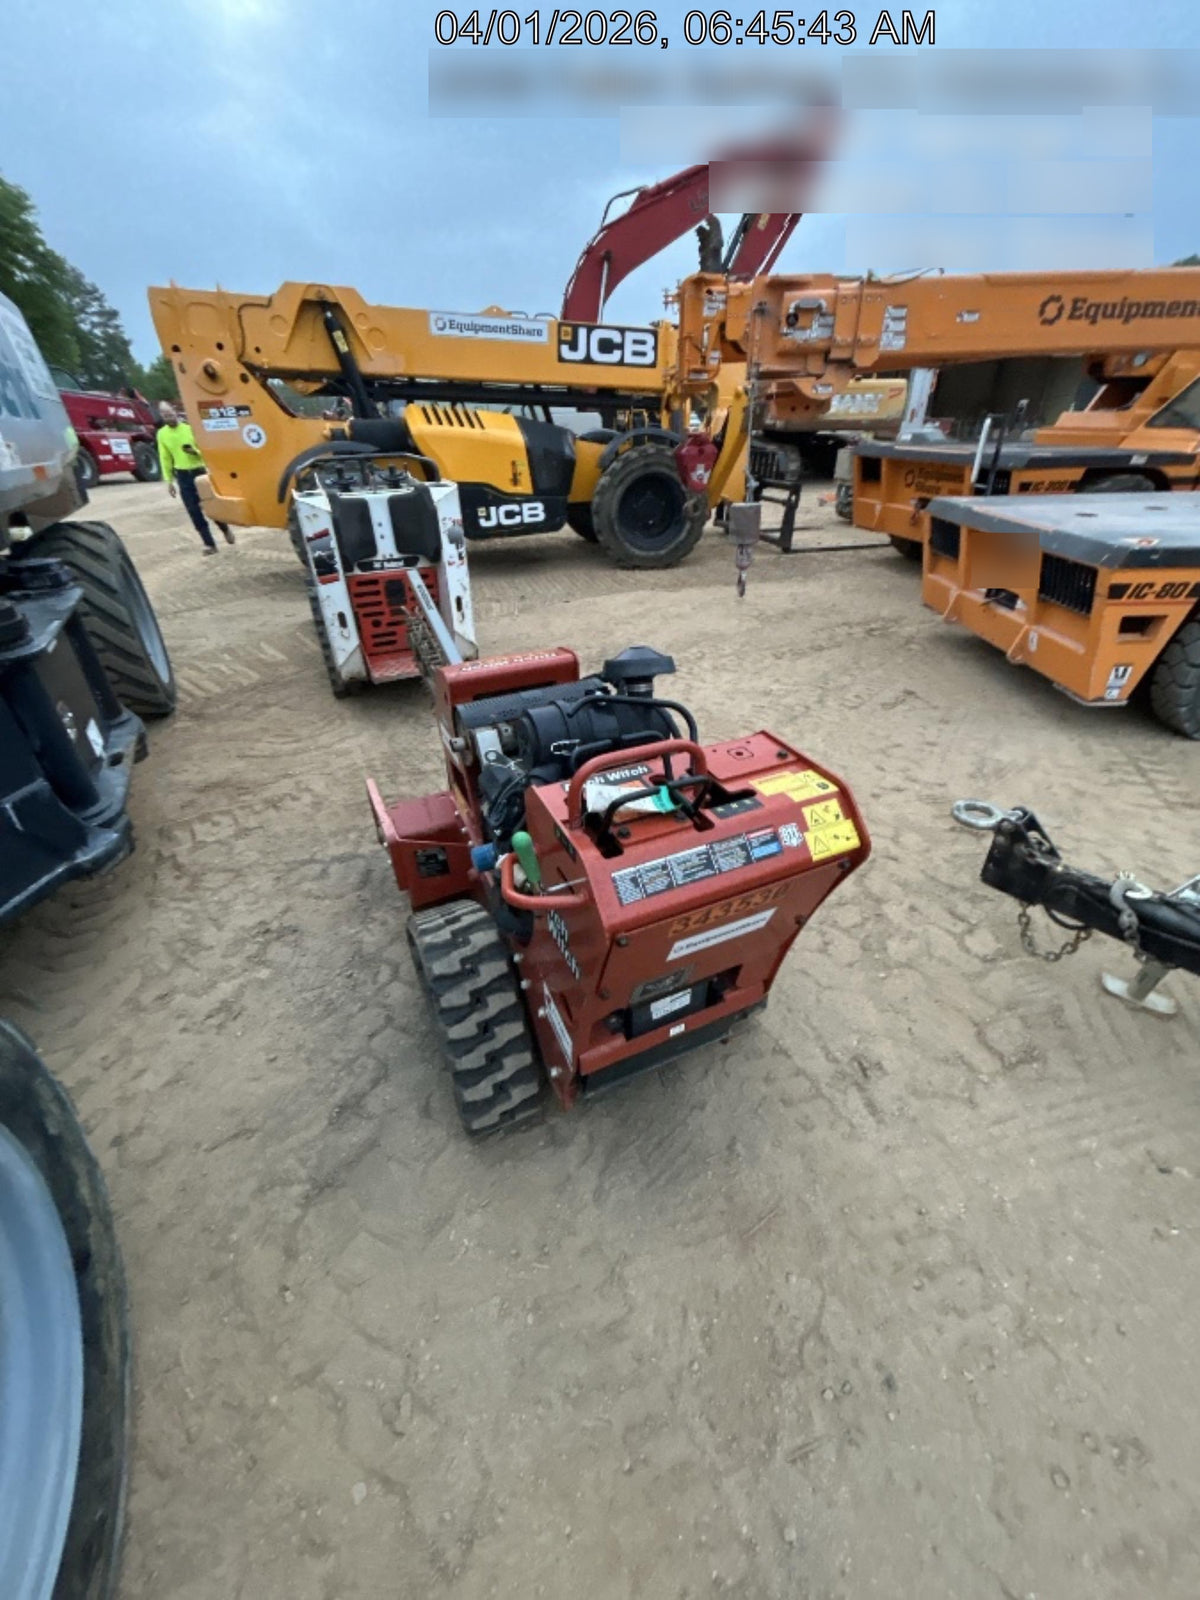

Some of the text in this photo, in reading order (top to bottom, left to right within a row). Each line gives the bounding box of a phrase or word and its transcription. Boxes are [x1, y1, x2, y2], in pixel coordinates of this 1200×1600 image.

[1067, 296, 1200, 325] Equipmen
[448, 319, 543, 338] EquipmentShare
[559, 325, 656, 366] JCB
[478, 501, 546, 527] JCB
[1126, 582, 1192, 600] IC-80
[606, 764, 649, 782] Witch
